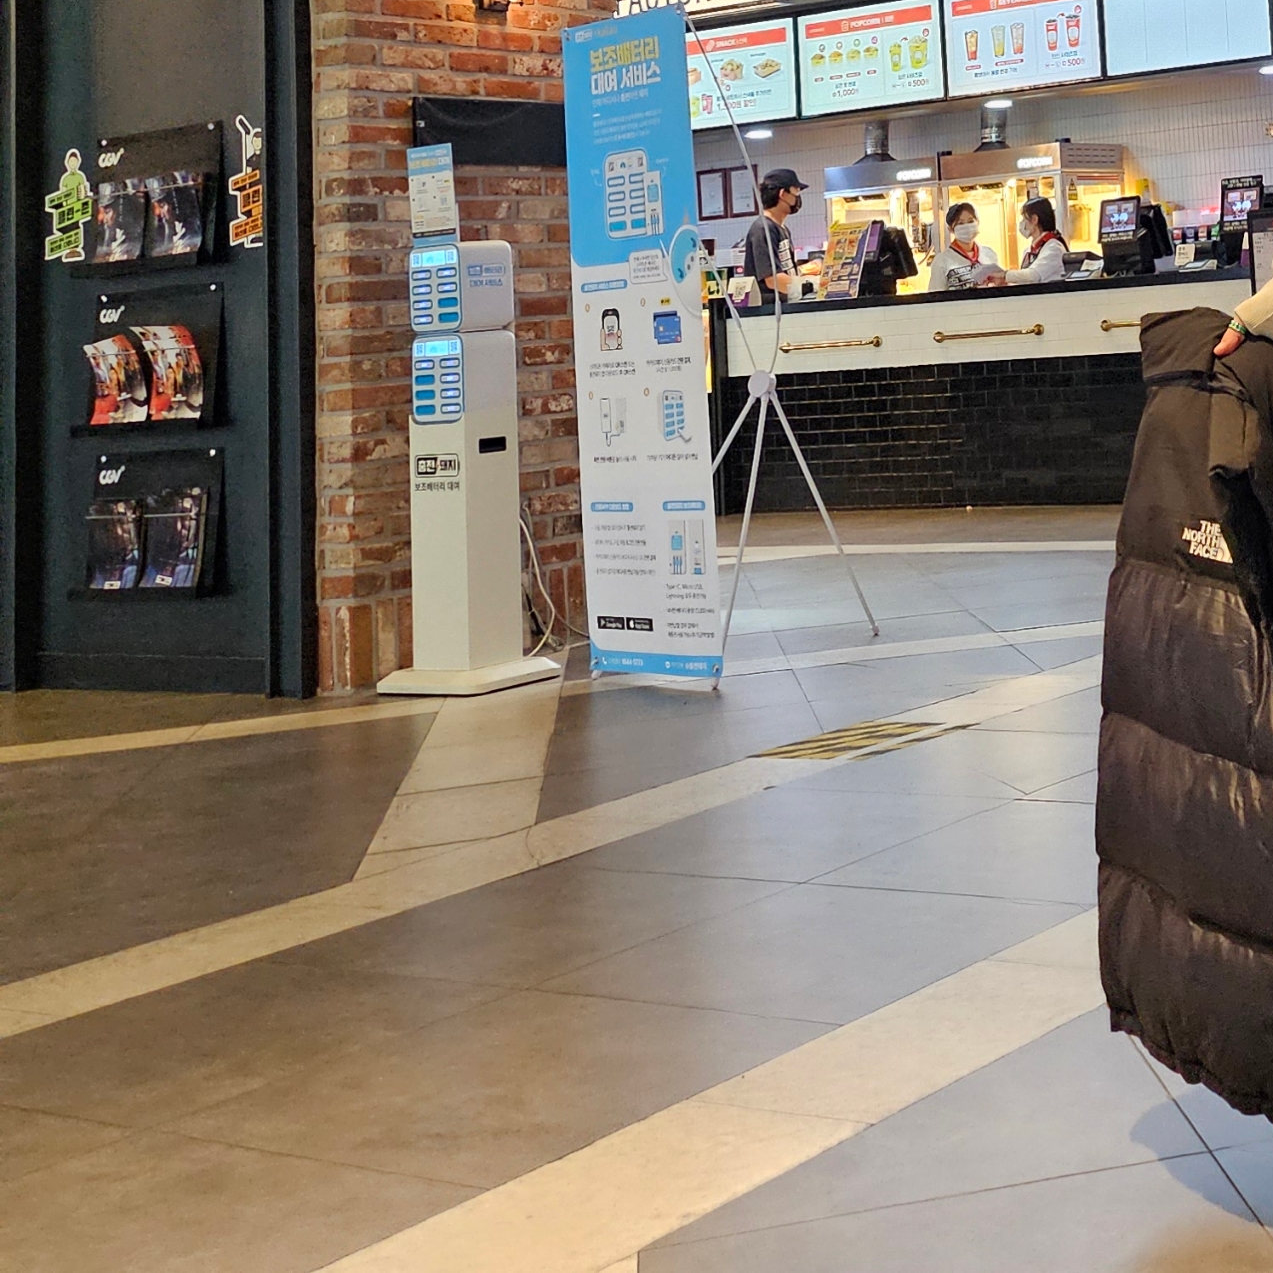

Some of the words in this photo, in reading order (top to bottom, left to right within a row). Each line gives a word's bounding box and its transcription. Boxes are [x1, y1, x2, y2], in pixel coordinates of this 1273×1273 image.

[850, 18, 880, 28] POPCORN
[715, 39, 736, 48] SNACK
[590, 35, 660, 73] 보조배터리
[591, 69, 618, 95] 대여
[620, 61, 661, 89] 서비스
[415, 482, 445, 492] 보조배터리
[1200, 520, 1221, 536] THE
[1182, 527, 1219, 547] NORTH
[1189, 541, 1218, 559] FACE
